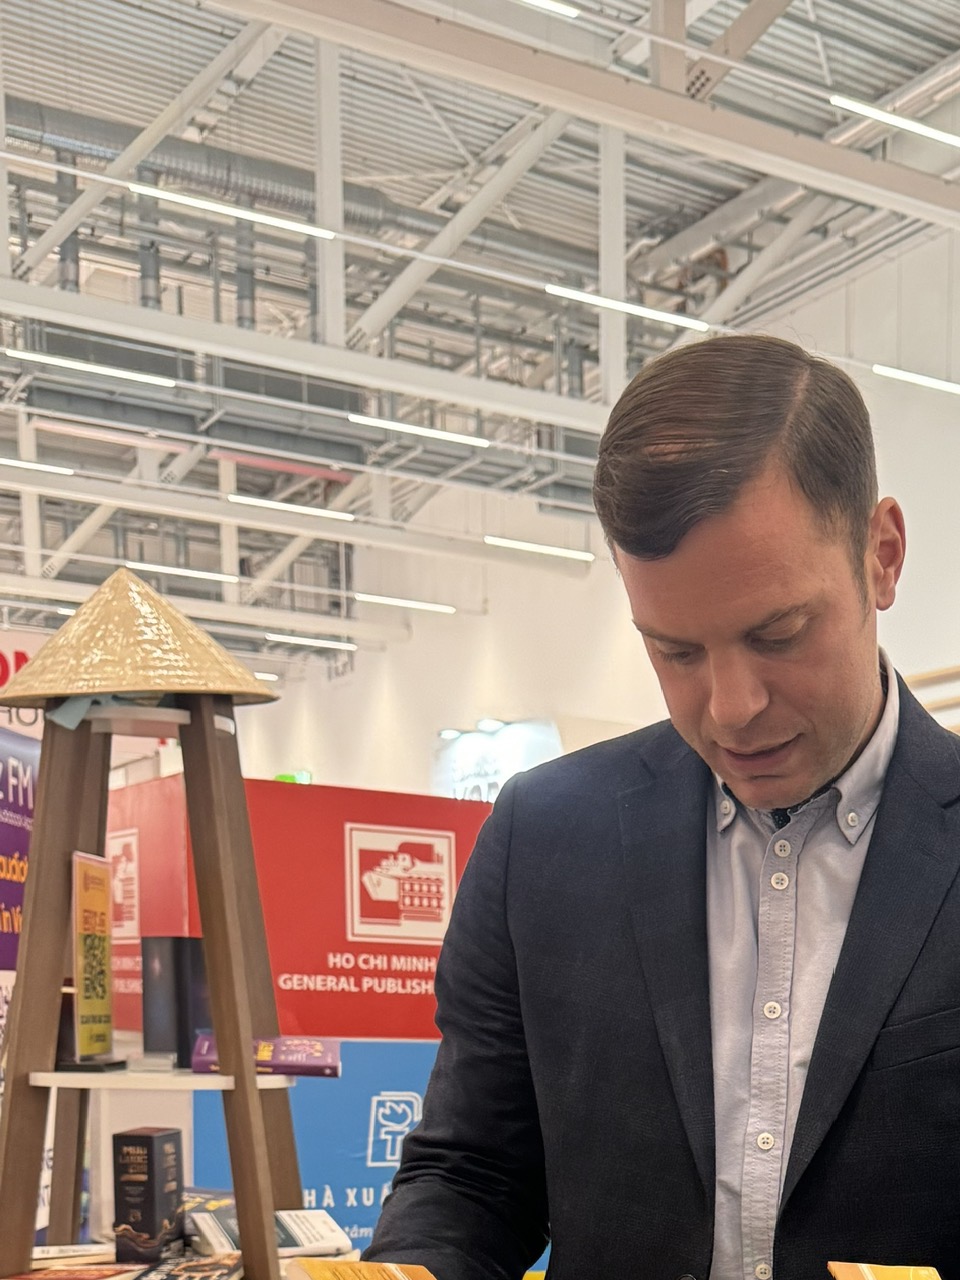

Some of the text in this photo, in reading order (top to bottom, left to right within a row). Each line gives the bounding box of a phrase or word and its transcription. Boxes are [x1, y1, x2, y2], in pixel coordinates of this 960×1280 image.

[327, 952, 437, 973] HO CHI MINH
[278, 973, 360, 993] GENERAL
